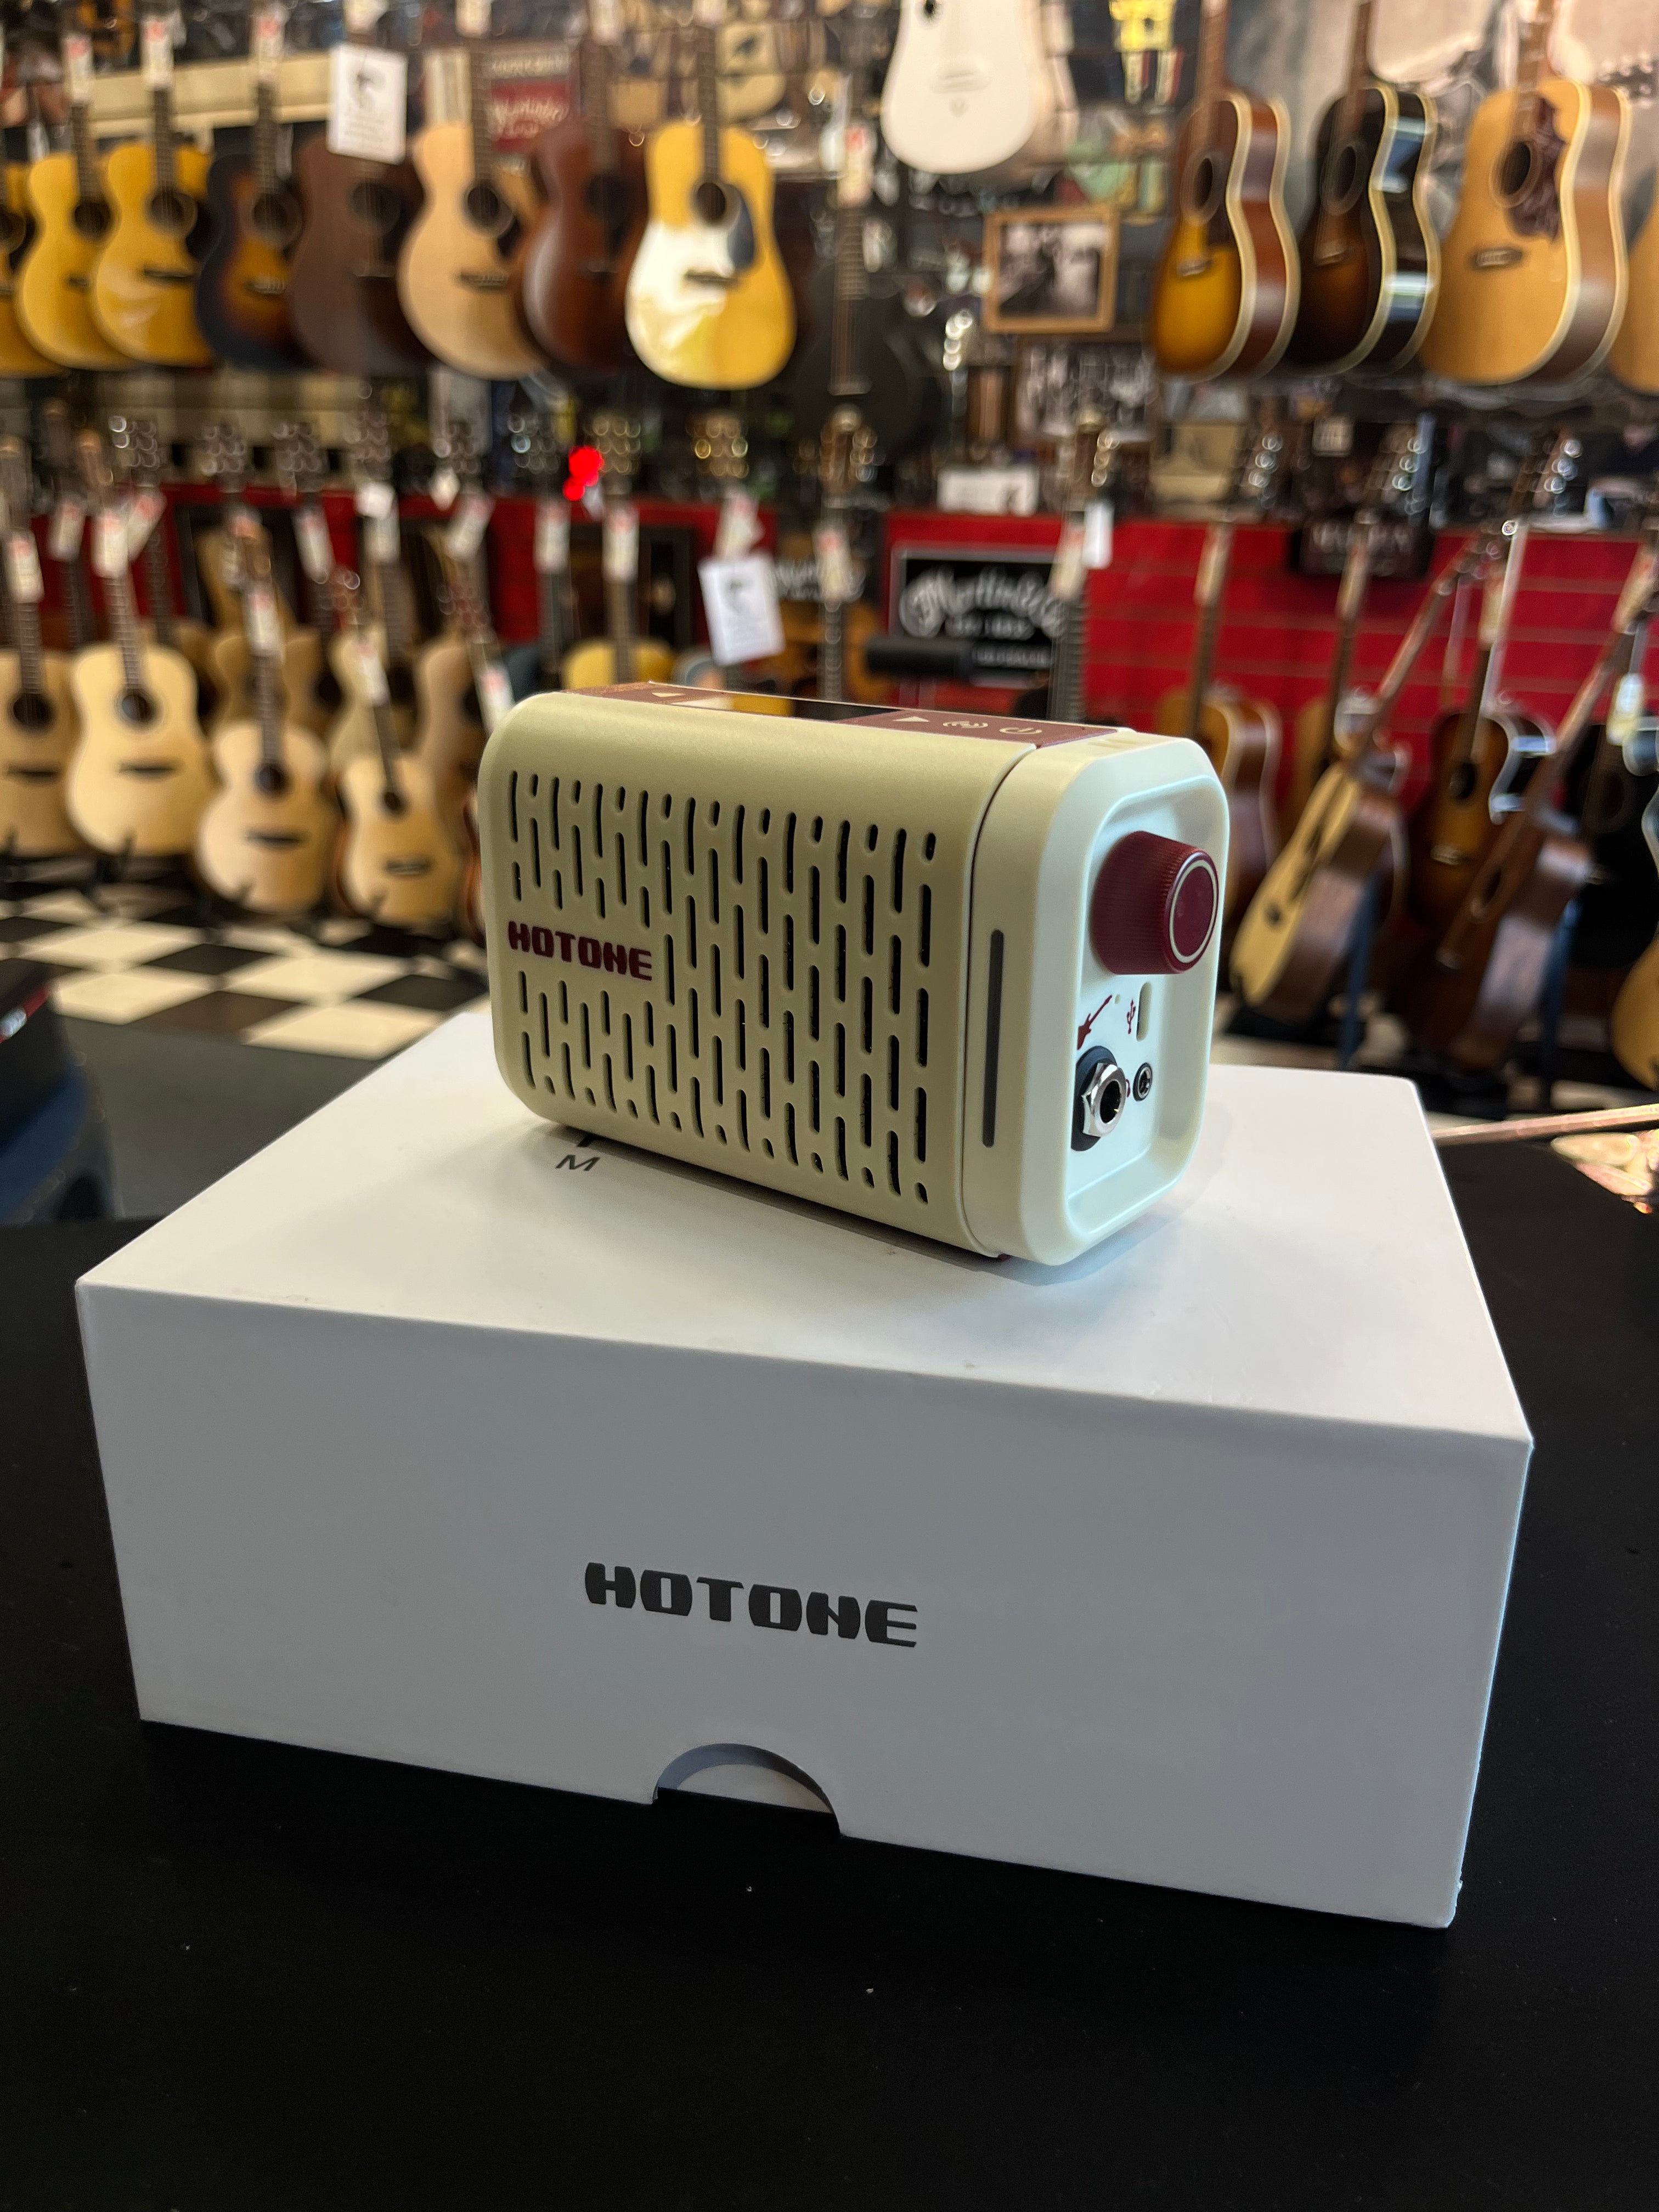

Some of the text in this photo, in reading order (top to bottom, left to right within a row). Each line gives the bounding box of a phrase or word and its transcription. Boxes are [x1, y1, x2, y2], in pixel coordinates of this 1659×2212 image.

[508, 921, 652, 981] HOTONE
[555, 1154, 601, 1171] M
[585, 1562, 918, 1647] HOTONE
